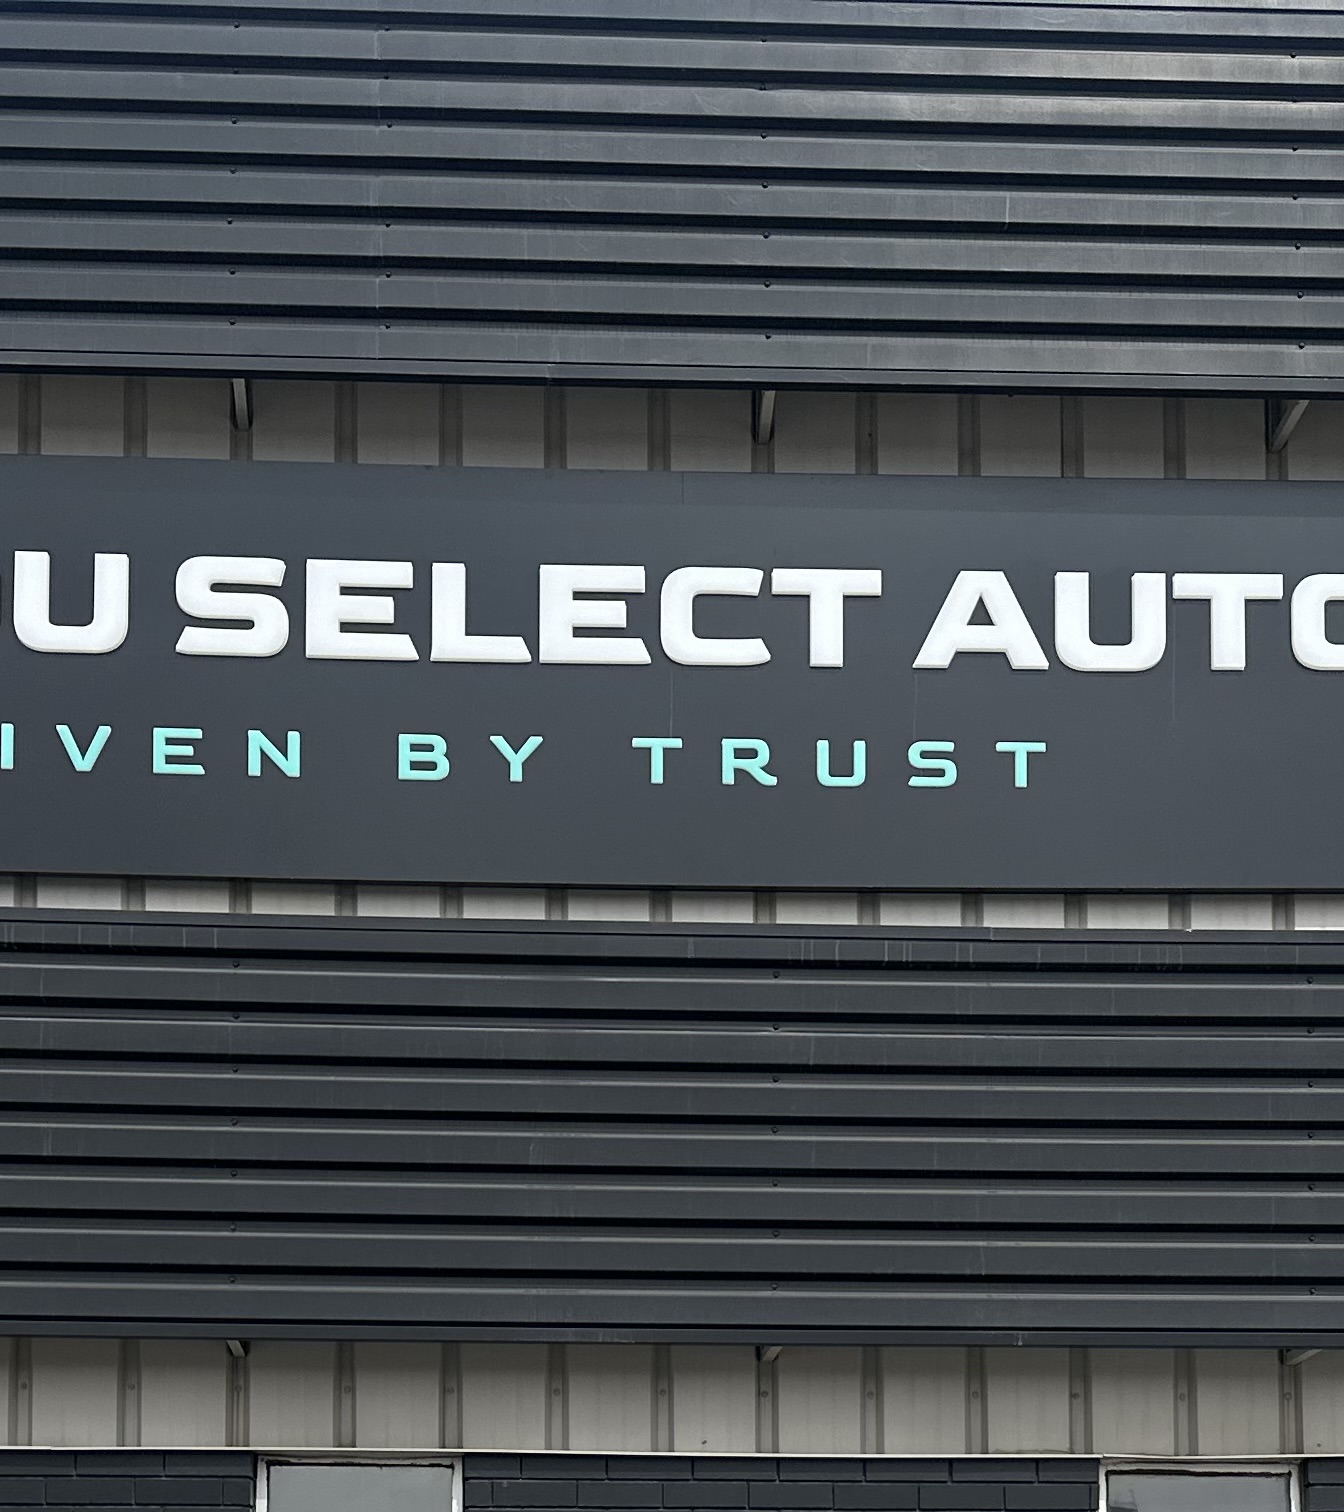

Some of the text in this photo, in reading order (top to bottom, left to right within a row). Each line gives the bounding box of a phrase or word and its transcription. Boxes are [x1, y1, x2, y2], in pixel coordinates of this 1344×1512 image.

[174, 555, 883, 669] SELECT
[397, 733, 545, 783] BY
[631, 737, 1048, 788] TRUST
